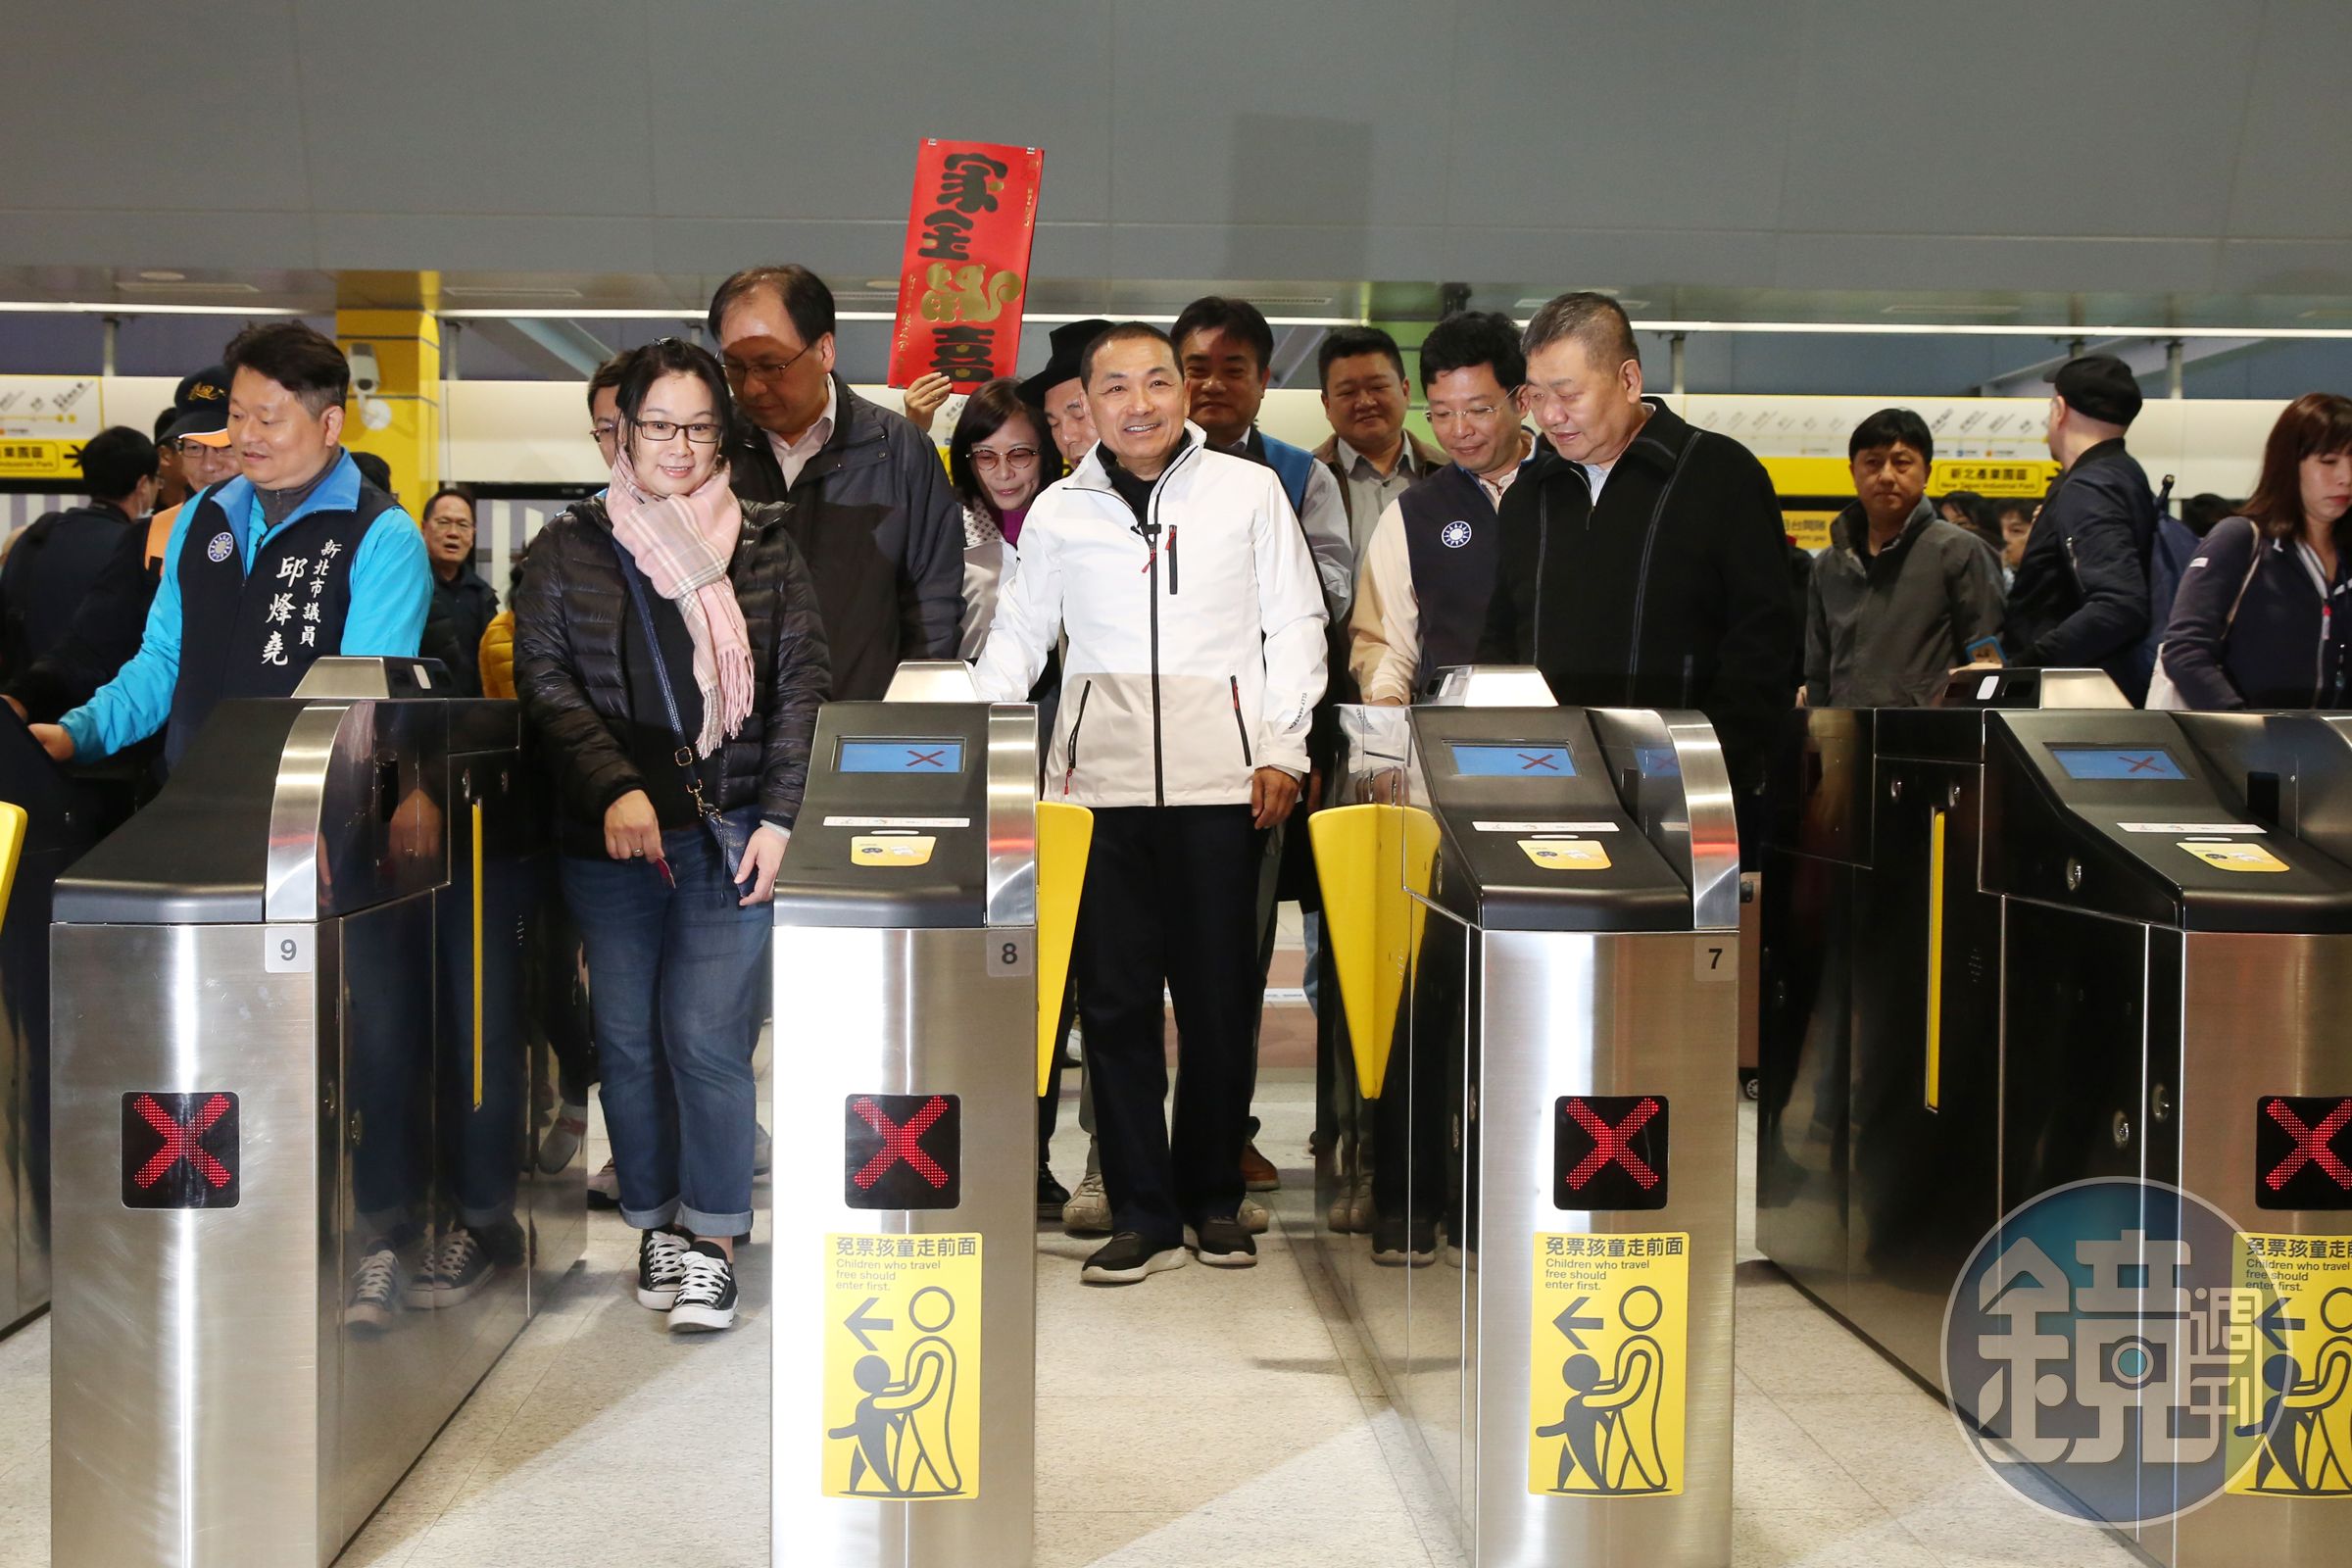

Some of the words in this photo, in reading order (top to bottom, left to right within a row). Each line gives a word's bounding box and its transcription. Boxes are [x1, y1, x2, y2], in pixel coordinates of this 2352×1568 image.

[0, 446, 43, 459] 業園區
[299, 539, 343, 648] 新北市議員
[261, 556, 309, 666] 邱烽堯
[280, 939, 297, 960] 9
[1002, 942, 1018, 964] 8
[1708, 948, 1723, 969] 7
[836, 1237, 976, 1257] 免票孩童走前面
[1545, 1236, 1684, 1257] 免票孩童走前面
[2245, 1237, 2352, 1258] 免票孩童走
[836, 1258, 881, 1269] Children
[884, 1261, 906, 1270] who
[910, 1260, 941, 1269] travel
[1545, 1258, 1592, 1269] Children
[1621, 1259, 1649, 1269] travel
[2246, 1258, 2293, 1270] Children
[2296, 1261, 2320, 1271] who
[2323, 1261, 2350, 1271] travel
[836, 1270, 857, 1279] free
[859, 1271, 896, 1281] should
[1545, 1269, 1567, 1279] free
[1570, 1270, 1606, 1280] should
[2246, 1269, 2267, 1279] free
[2271, 1271, 2309, 1281] should
[866, 1281, 890, 1292] first.
[1545, 1281, 1573, 1290] enter
[1577, 1281, 1600, 1291] first.
[2278, 1281, 2303, 1292] first.
